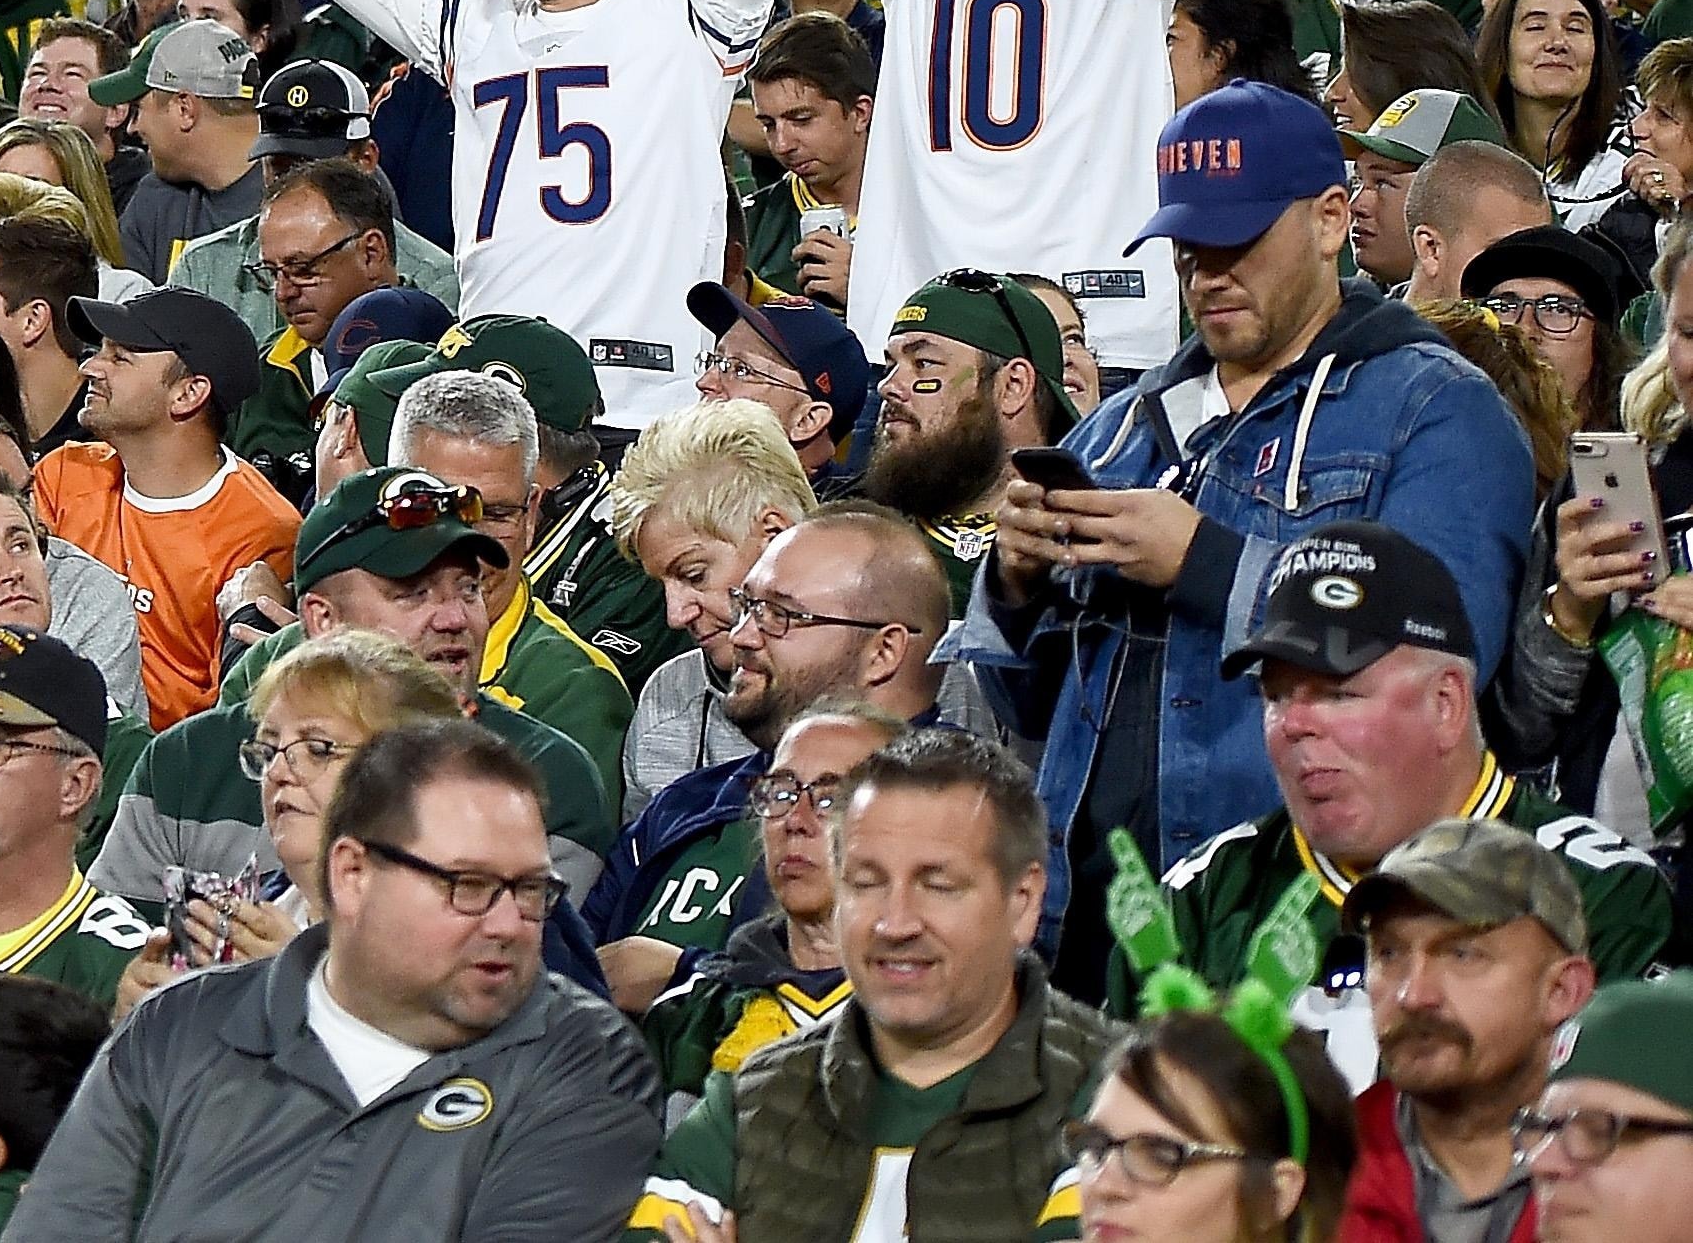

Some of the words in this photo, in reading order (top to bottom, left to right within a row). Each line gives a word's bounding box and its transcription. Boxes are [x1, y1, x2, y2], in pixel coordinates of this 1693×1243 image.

[473, 64, 612, 244] 75
[1310, 575, 1366, 609] G
[1404, 618, 1449, 642] Reebok
[416, 1077, 495, 1133] G
